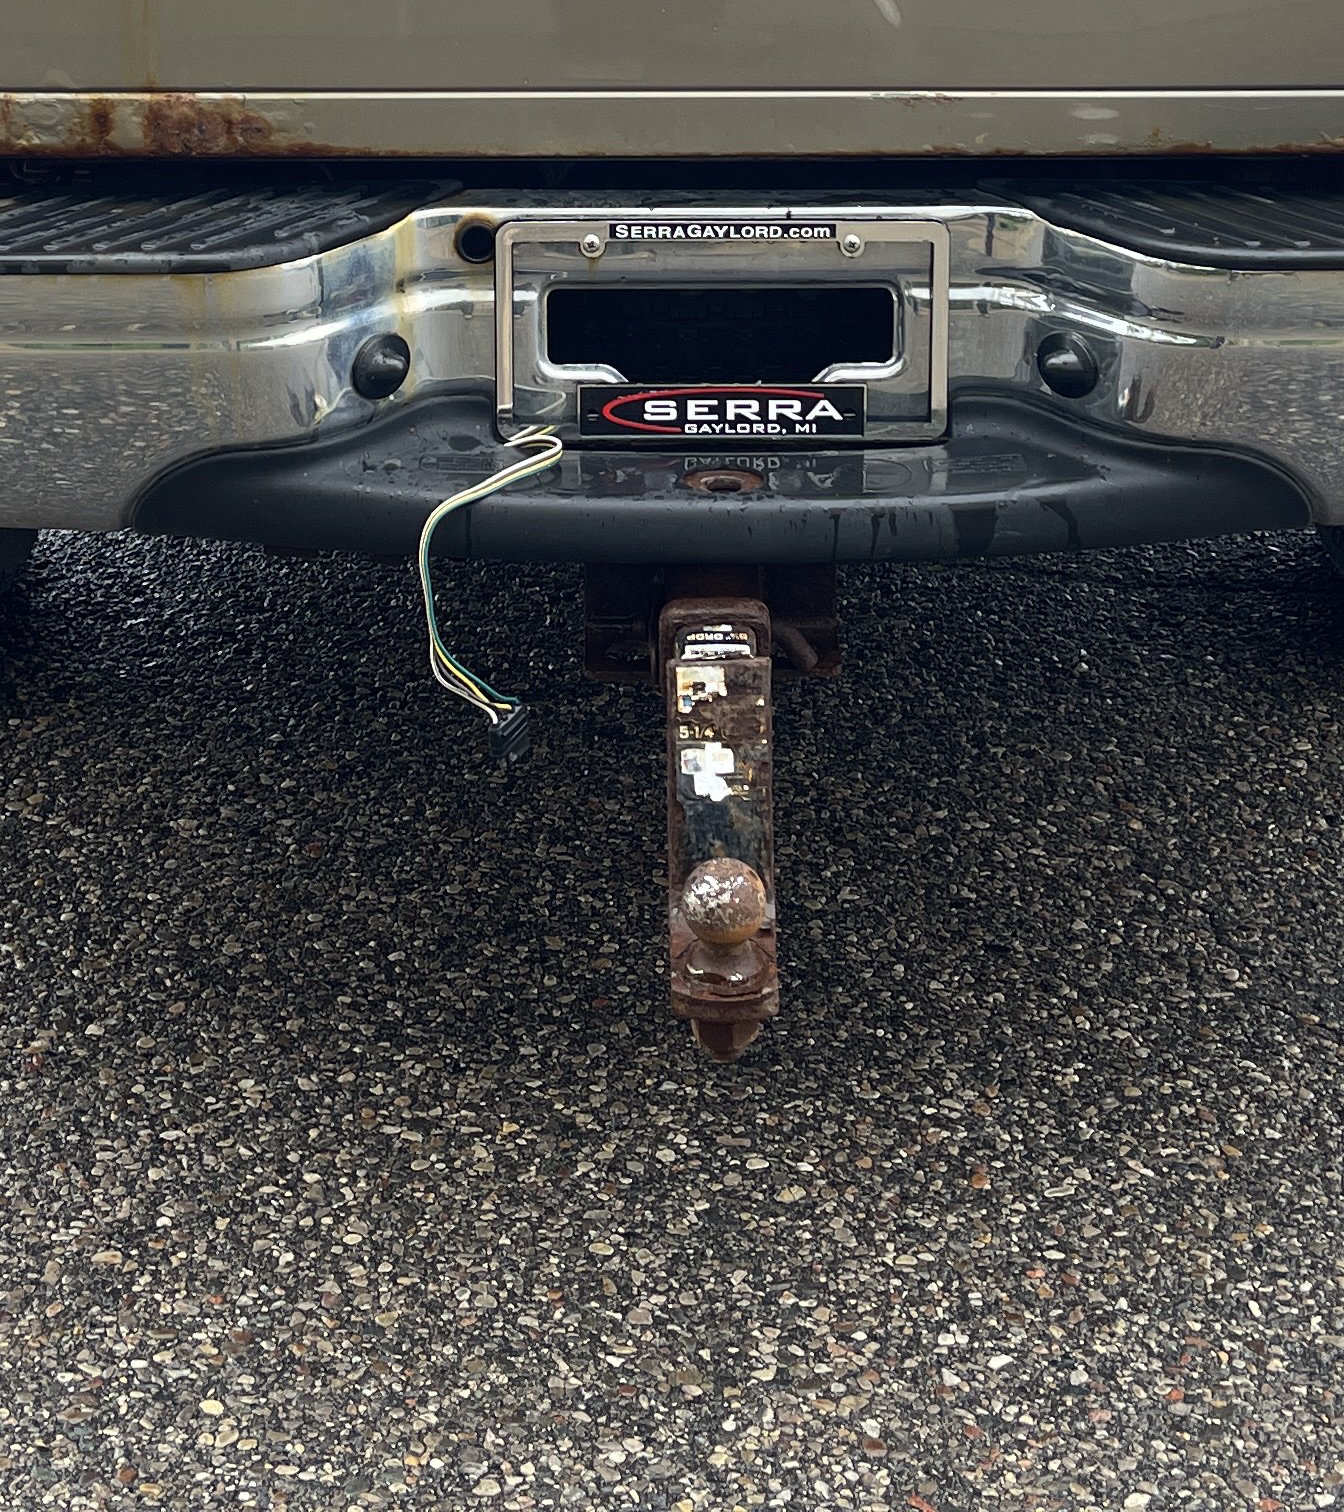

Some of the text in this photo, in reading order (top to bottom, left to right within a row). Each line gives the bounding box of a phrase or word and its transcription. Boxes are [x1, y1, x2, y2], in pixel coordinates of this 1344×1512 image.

[643, 399, 844, 421] SERRA
[683, 423, 818, 435] GAYLORD, MI
